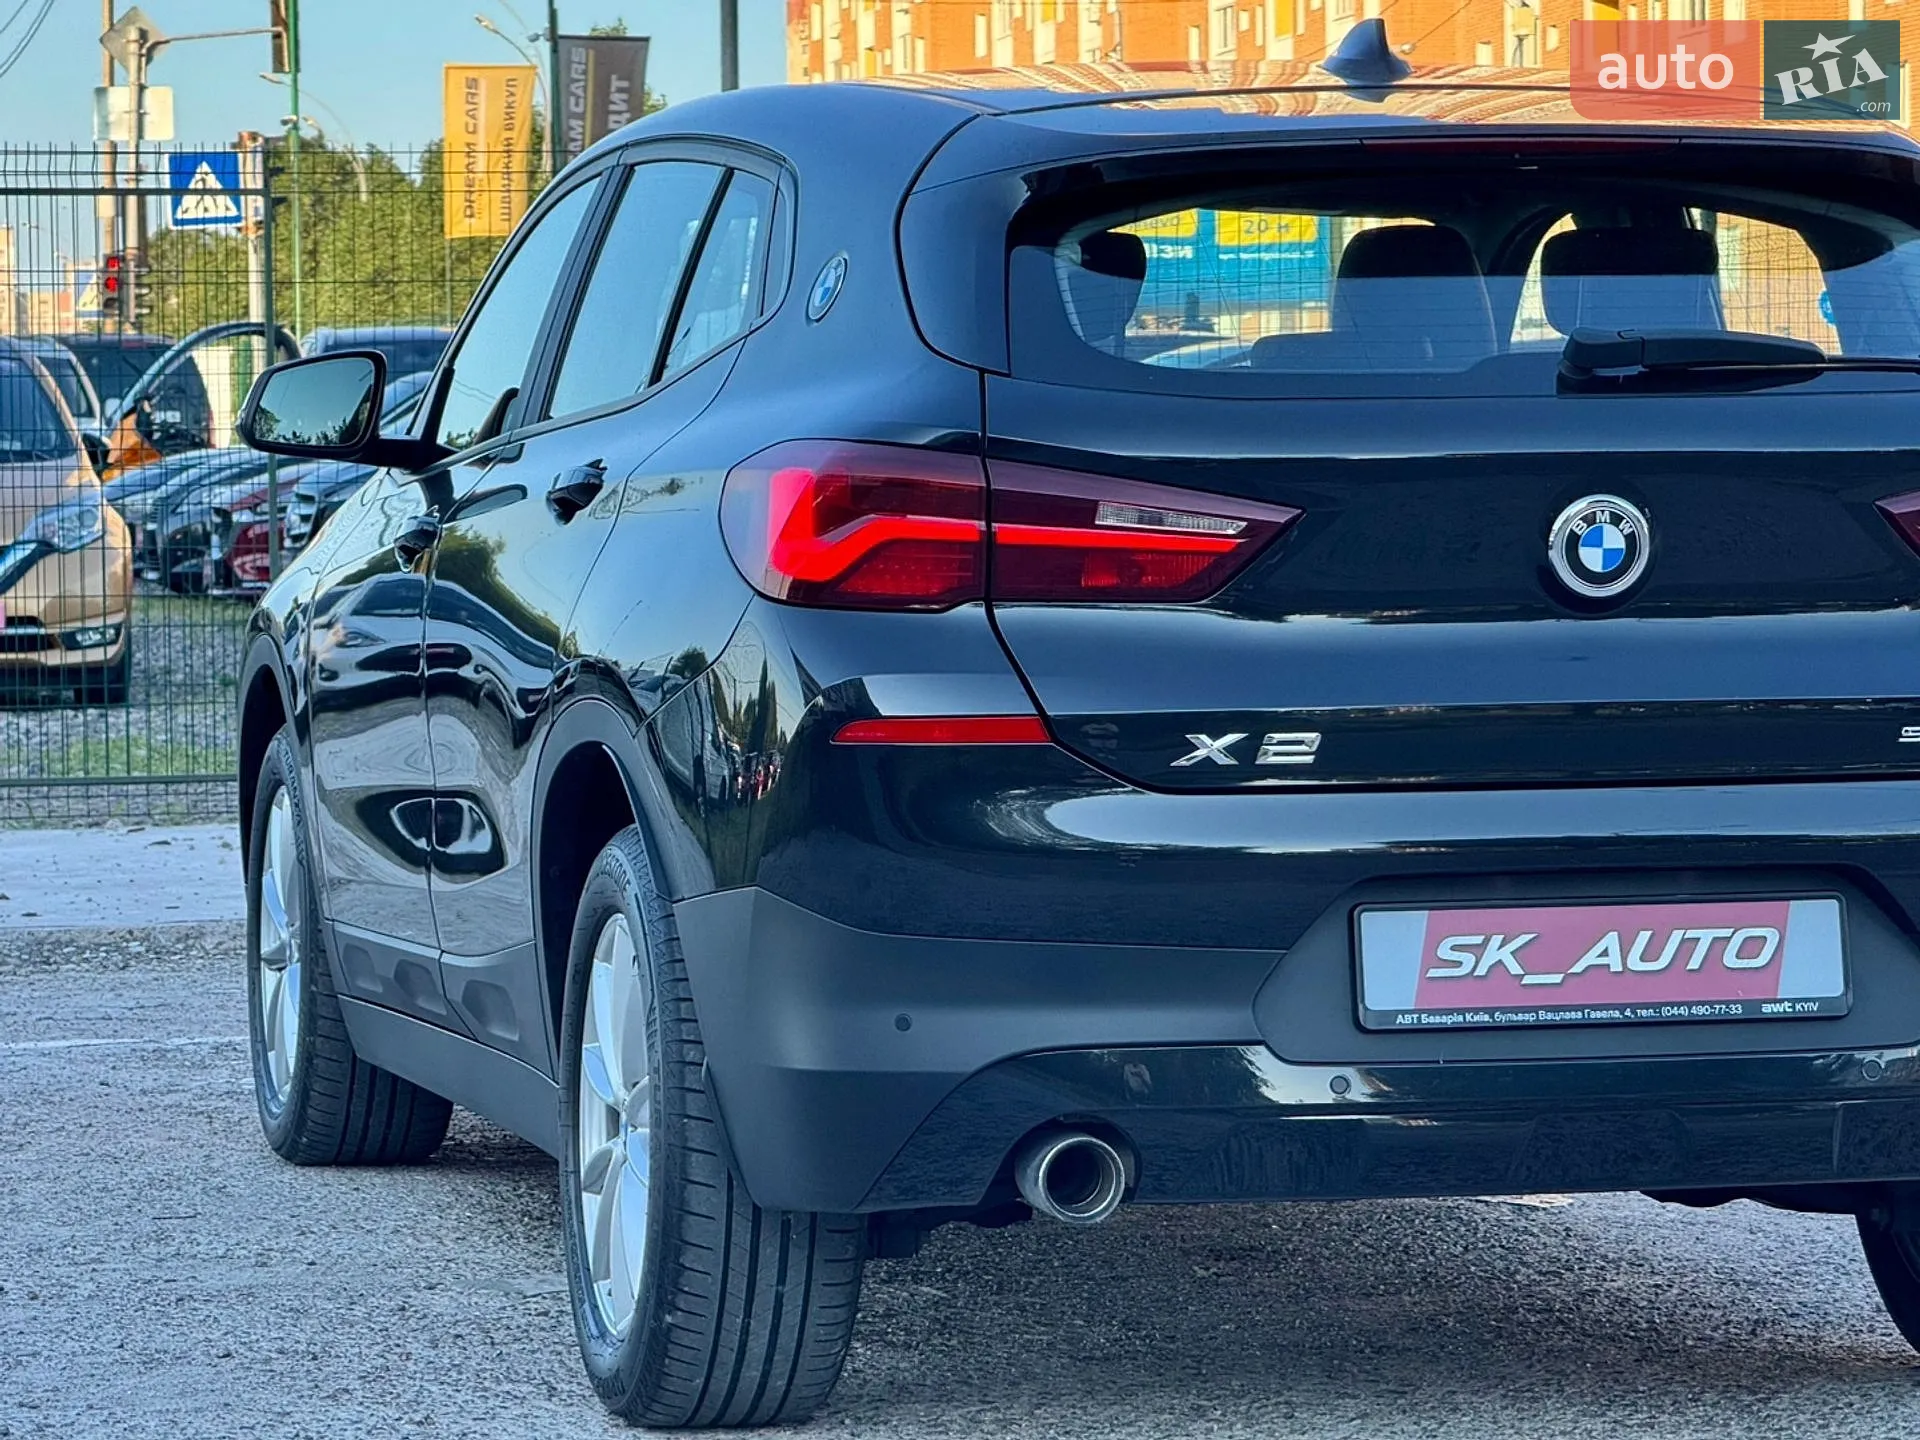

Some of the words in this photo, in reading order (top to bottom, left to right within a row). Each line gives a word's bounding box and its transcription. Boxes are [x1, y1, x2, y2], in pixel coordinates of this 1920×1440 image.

[464, 76, 479, 134] CARS
[503, 78, 518, 131] ВИКУП
[569, 47, 586, 113] CARS
[464, 141, 476, 218] DREAM
[1571, 510, 1633, 536] BMW
[1170, 732, 1322, 766] X2
[1426, 926, 1781, 986] SK_AUTO
[1396, 1014, 1419, 1024] АВТ
[1661, 1006, 1688, 1017] (044)
[1690, 1004, 1742, 1015] 490-77-33
[1761, 1001, 1793, 1013] awt
[1794, 1002, 1818, 1012] KYIV
